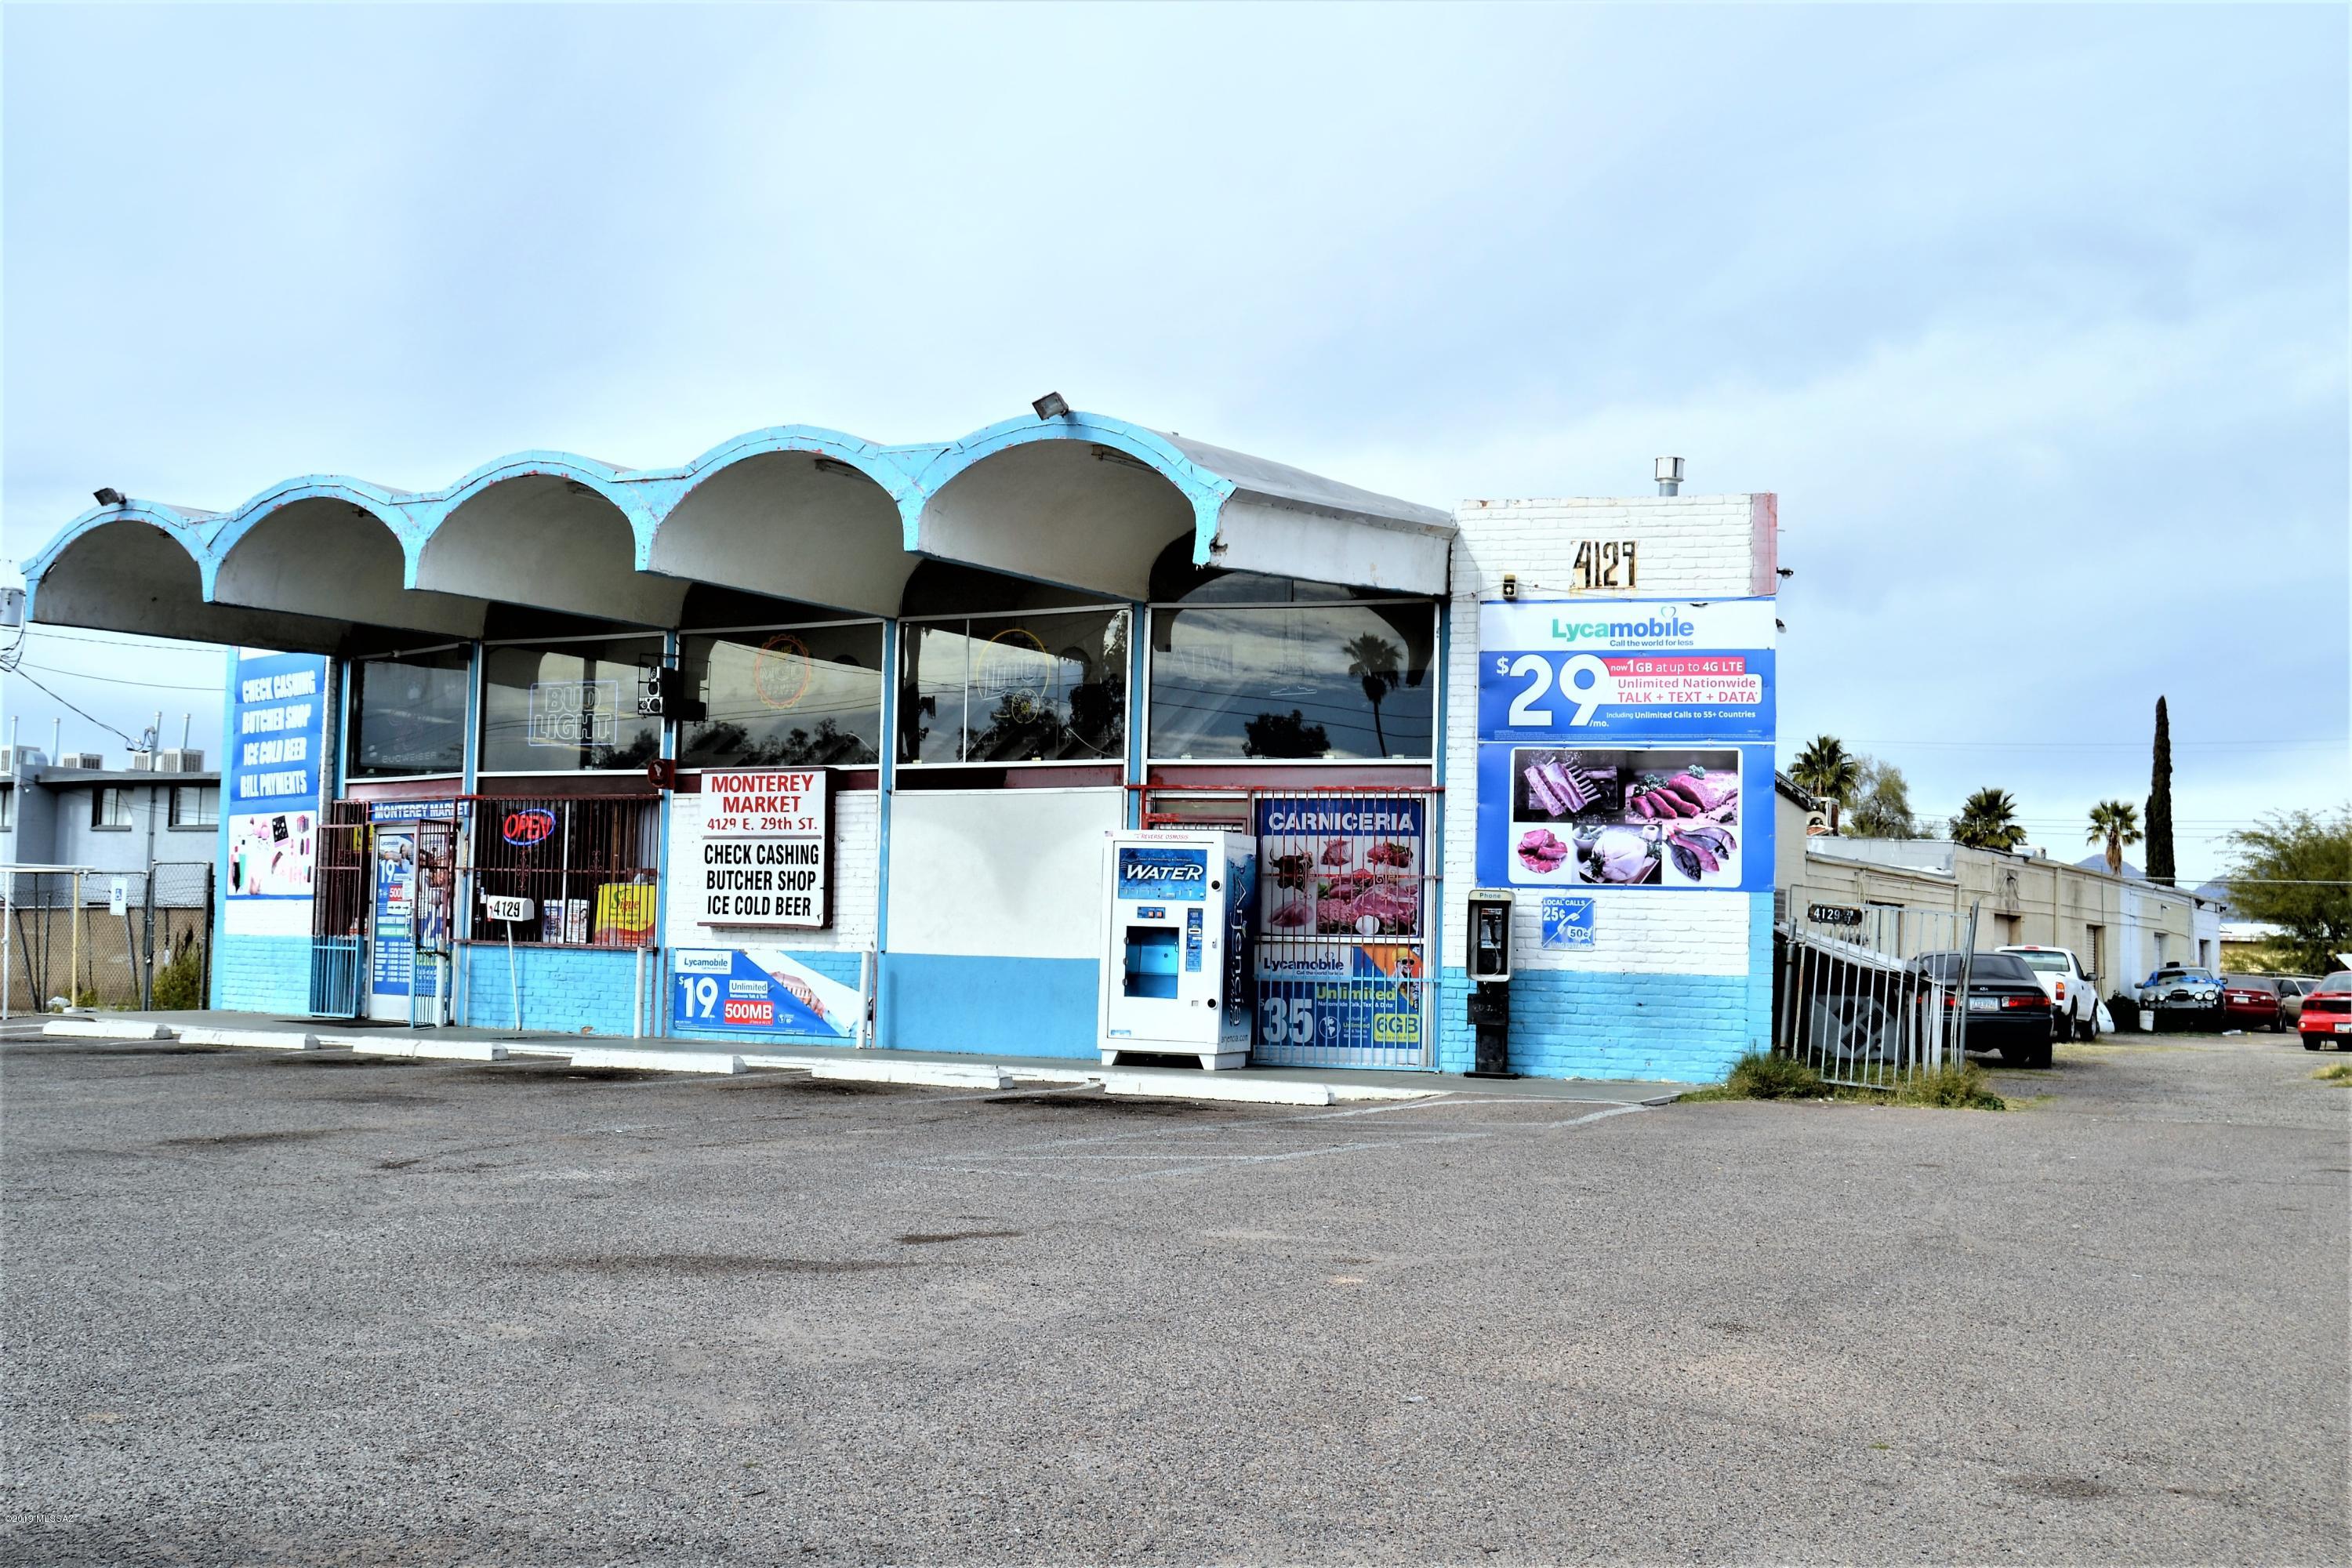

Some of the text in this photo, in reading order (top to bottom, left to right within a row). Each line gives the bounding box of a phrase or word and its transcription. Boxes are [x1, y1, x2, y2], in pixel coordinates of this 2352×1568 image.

[1573, 541, 1635, 588] 4129
[1552, 617, 1694, 642] Lycamobile
[1656, 662, 1667, 673] at
[1670, 663, 1684, 674] up
[1688, 662, 1700, 672] to
[1702, 662, 1719, 671] 4G
[1722, 662, 1743, 671] LTE
[242, 670, 316, 703] CHECK CASHING
[1618, 677, 1756, 688] Unlimited Nationwide
[545, 686, 601, 713] BUD
[1617, 692, 1652, 702] TALK
[1668, 691, 1701, 702] TEXT
[241, 703, 312, 735] BUTCHER SHOP
[533, 713, 612, 739] LIGHT
[243, 737, 307, 766] ICE COLD BEER
[240, 770, 307, 798] BILL PAYMENTS
[712, 775, 814, 793] MONTEREY
[375, 804, 428, 819] MONTEREY
[723, 796, 801, 813] MARKET
[504, 814, 552, 840] OPEN
[707, 817, 818, 830] 4129 E. 29th ST.
[1269, 813, 1414, 831] CARNICERIA
[705, 844, 818, 865] CHECK CASHING
[706, 870, 816, 891] BUTCHER SHOP
[1127, 864, 1203, 880] WATER
[390, 887, 402, 898] 500
[493, 900, 520, 917] 4129
[707, 895, 811, 916] ICE COLD BEER
[1813, 908, 1840, 920] 4129
[1543, 907, 1566, 922] 25¢
[684, 957, 728, 967] Lycamobile
[1264, 958, 1344, 971] Lycamobile
[731, 982, 767, 992] Unlimited
[1316, 986, 1396, 1001] Unlimited
[724, 1004, 772, 1019] 500MB
[1377, 1016, 1418, 1033] 6GB
